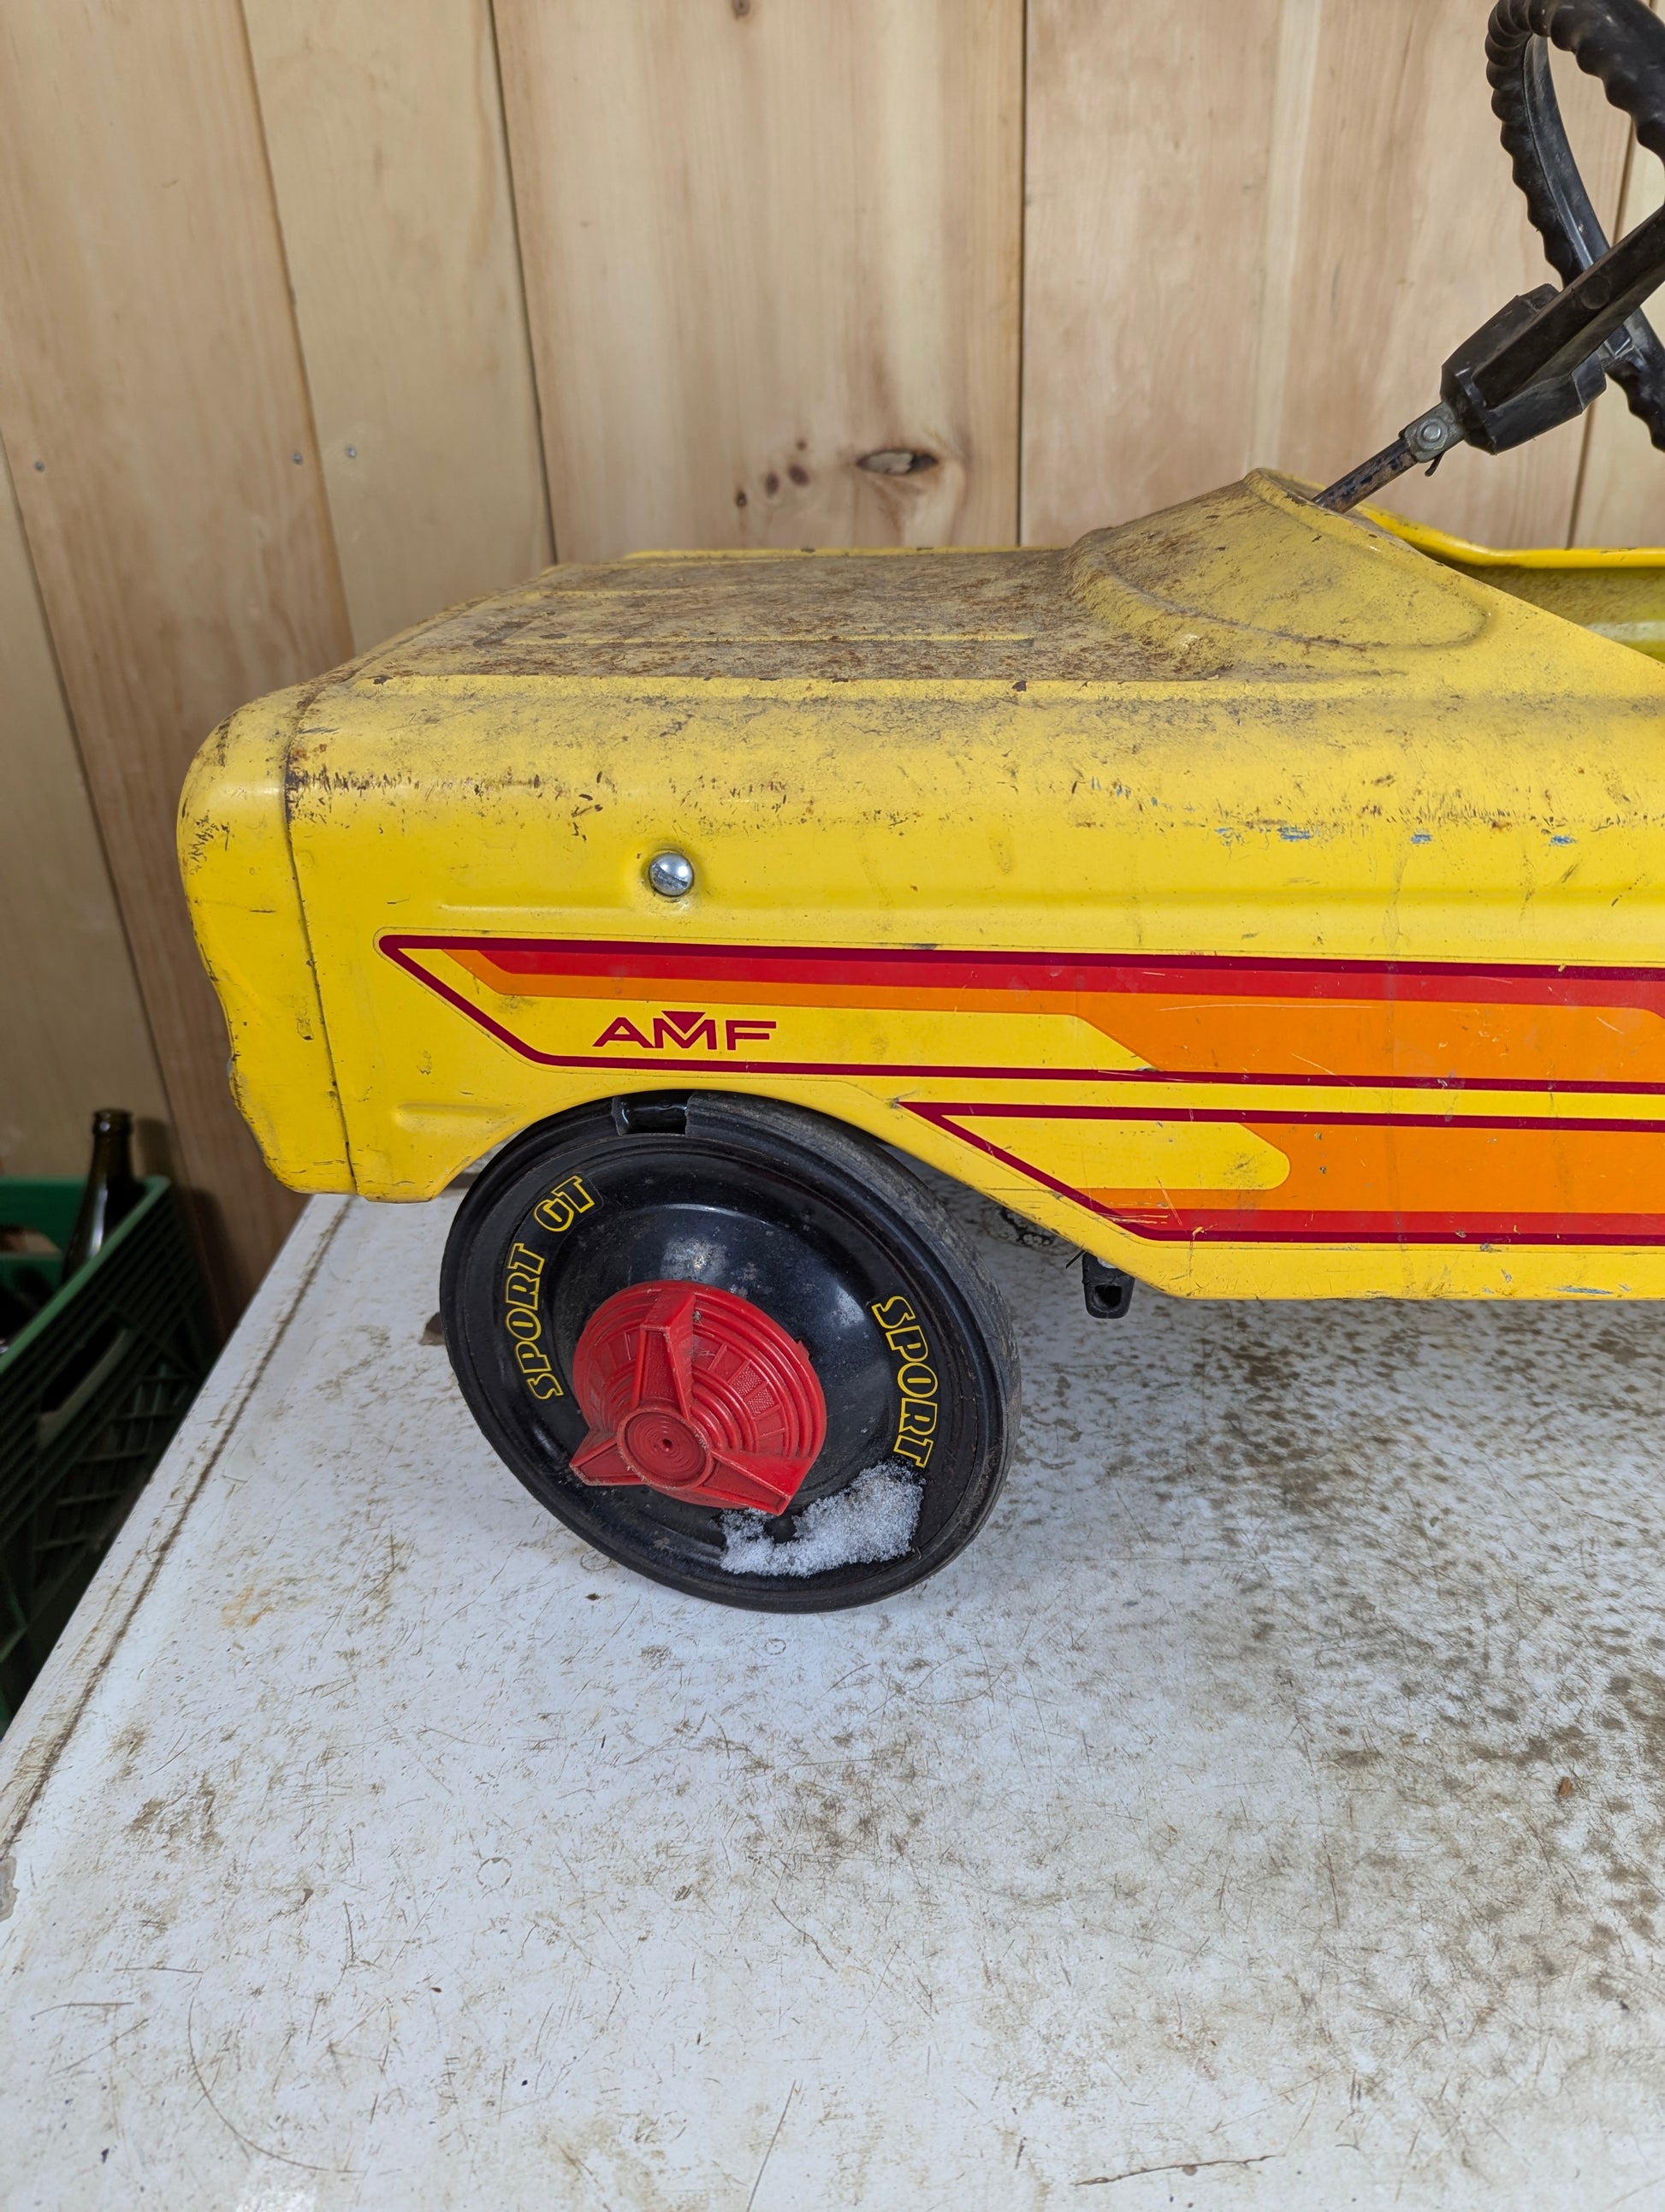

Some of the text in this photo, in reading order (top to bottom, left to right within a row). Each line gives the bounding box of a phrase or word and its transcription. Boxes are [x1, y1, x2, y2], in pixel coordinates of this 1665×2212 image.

[592, 1011, 777, 1051] AMF
[506, 1175, 595, 1400] SPORT GT
[871, 1296, 939, 1468] SPORT
